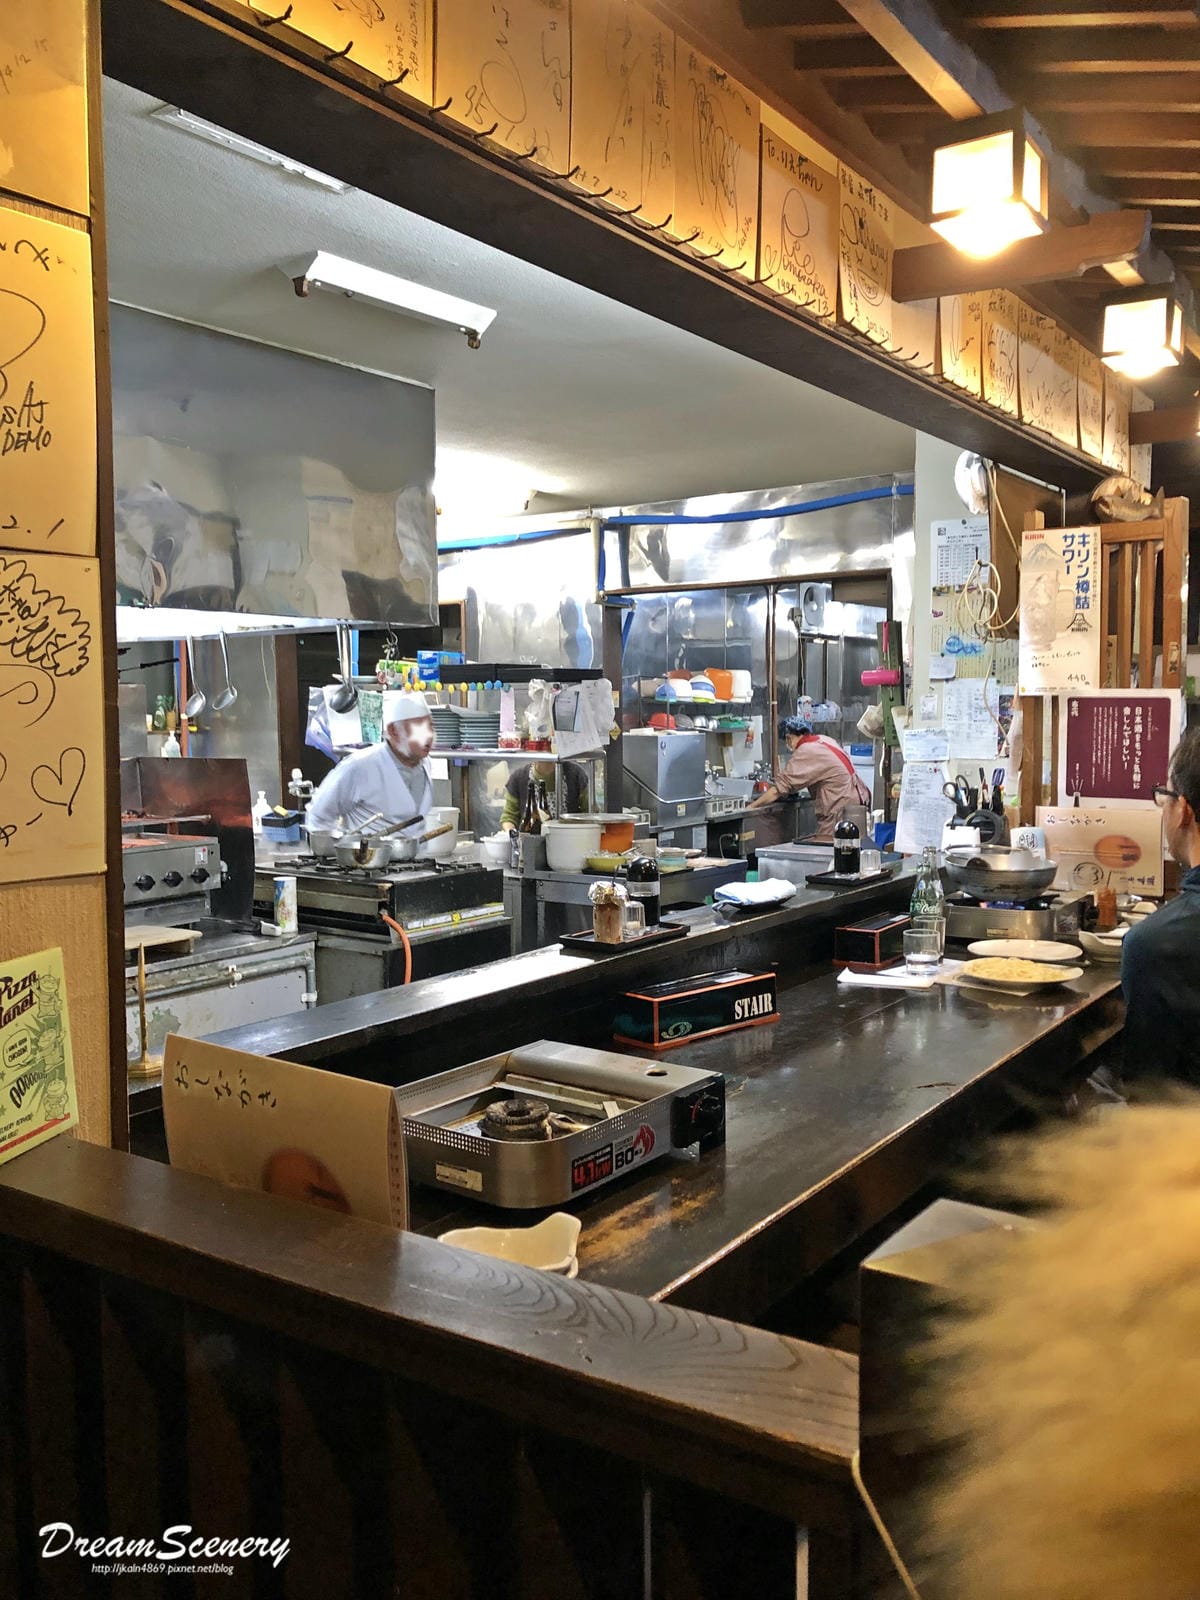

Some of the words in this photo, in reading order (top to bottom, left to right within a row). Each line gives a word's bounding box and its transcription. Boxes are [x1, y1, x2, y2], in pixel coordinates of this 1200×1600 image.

[2, 425, 52, 456] DEMO
[1024, 533, 1045, 541] KIRIN
[1062, 533, 1076, 576] サワー
[1075, 532, 1091, 609] キリン樽詰
[734, 992, 774, 1020] STAIR
